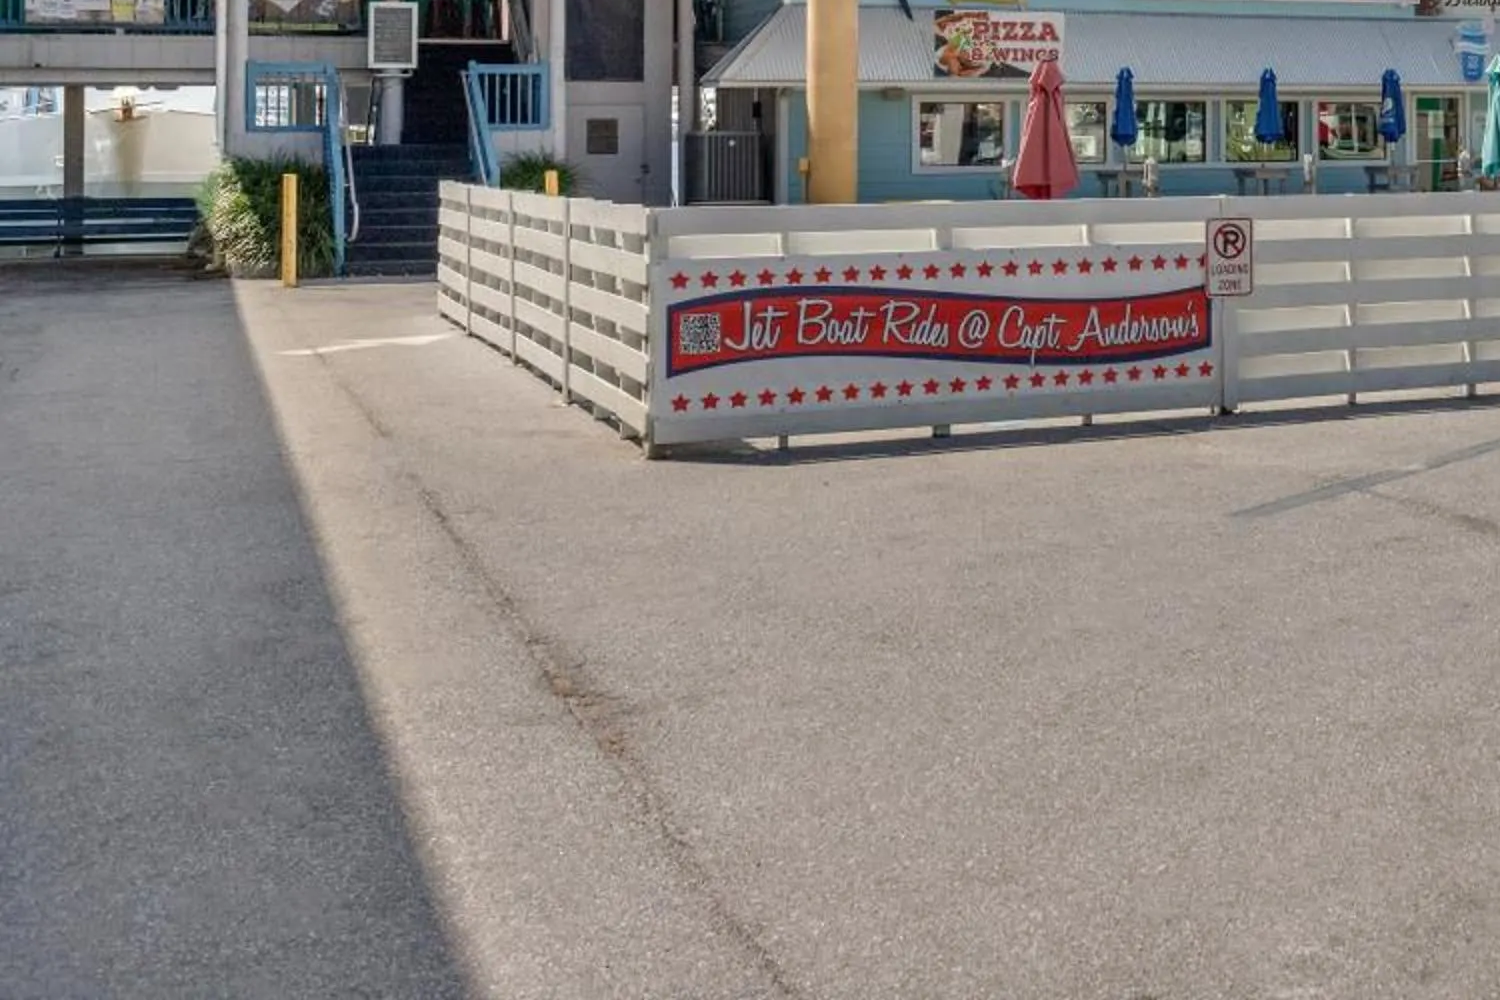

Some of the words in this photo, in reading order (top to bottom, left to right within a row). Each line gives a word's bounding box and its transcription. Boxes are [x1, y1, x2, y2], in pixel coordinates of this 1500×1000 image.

[972, 21, 1059, 41] PIZZA
[991, 47, 1059, 63] WINGS
[1211, 263, 1249, 276] LOADING
[1218, 279, 1242, 290] ZONE
[724, 300, 789, 351] Jet
[797, 297, 876, 345] Boat
[879, 299, 949, 348] Rides
[958, 309, 990, 349] @
[998, 305, 1068, 369] Capt.
[1068, 300, 1200, 351] Anderson's
